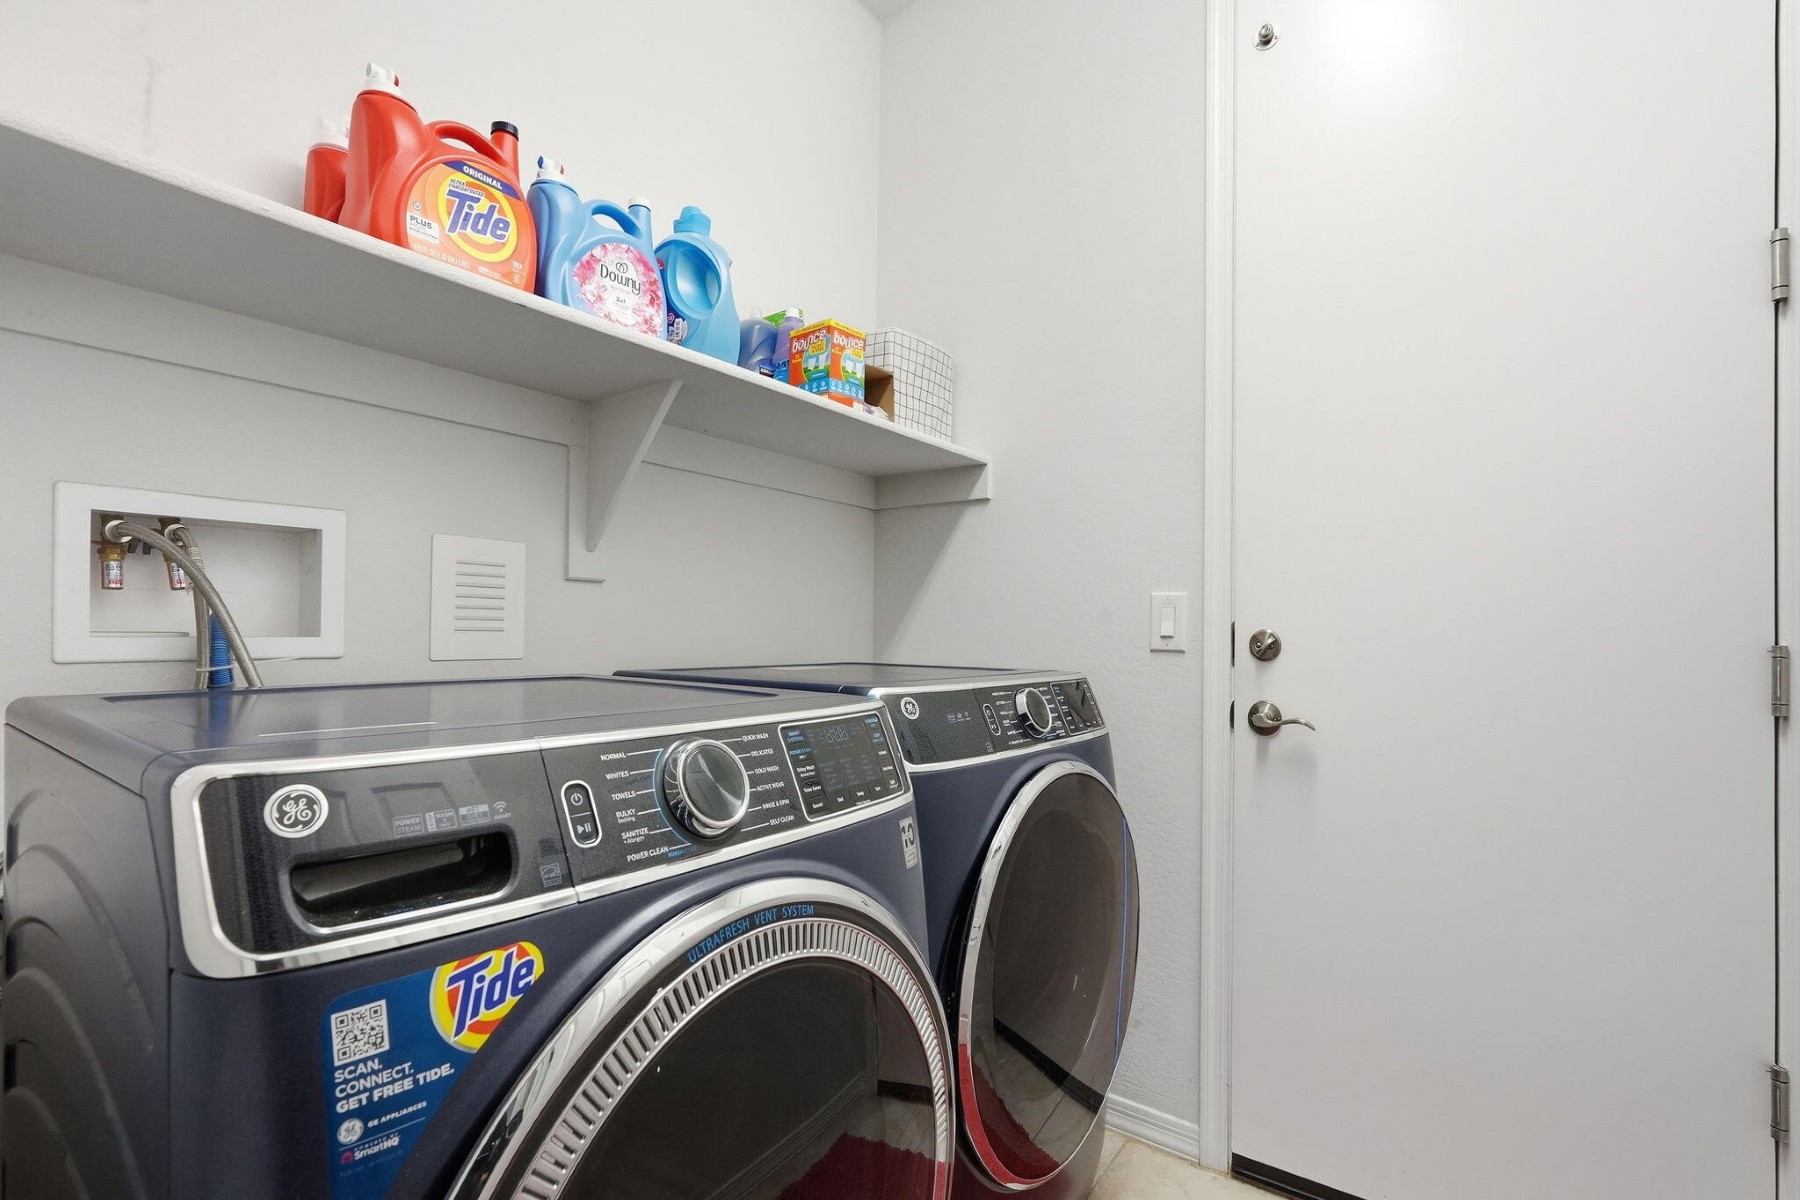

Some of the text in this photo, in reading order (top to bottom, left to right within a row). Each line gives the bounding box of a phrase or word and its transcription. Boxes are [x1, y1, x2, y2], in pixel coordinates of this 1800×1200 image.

[463, 165, 503, 190] ORIGINAL
[409, 215, 432, 230] PLUS
[446, 189, 511, 241] Tide
[600, 263, 641, 295] Downy
[792, 328, 827, 353] bounce
[833, 329, 864, 349] bounce
[756, 732, 769, 740] WASH
[600, 751, 627, 761] NORMAL
[751, 748, 774, 757] DELICATES
[606, 770, 629, 780] WHITES
[767, 765, 779, 773] WASH
[611, 790, 636, 801] TOWELS
[493, 812, 512, 820] SMART
[616, 808, 636, 818] BULKY
[769, 815, 795, 826] SELF CLEAN
[394, 817, 420, 827] POWER
[621, 827, 649, 840] SANITIZE
[627, 845, 669, 862] POWER CLEAN
[688, 905, 814, 963] ULTRAFRESH VENT SYSTEM
[446, 949, 535, 1039] Tide
[334, 1058, 382, 1083] SCAN.
[335, 1062, 414, 1098] CONNECT.
[336, 1063, 455, 1113] GET FREE TIDE.
[367, 1101, 428, 1128] GE APPLIANCES
[354, 1135, 400, 1160] SmartHQ
